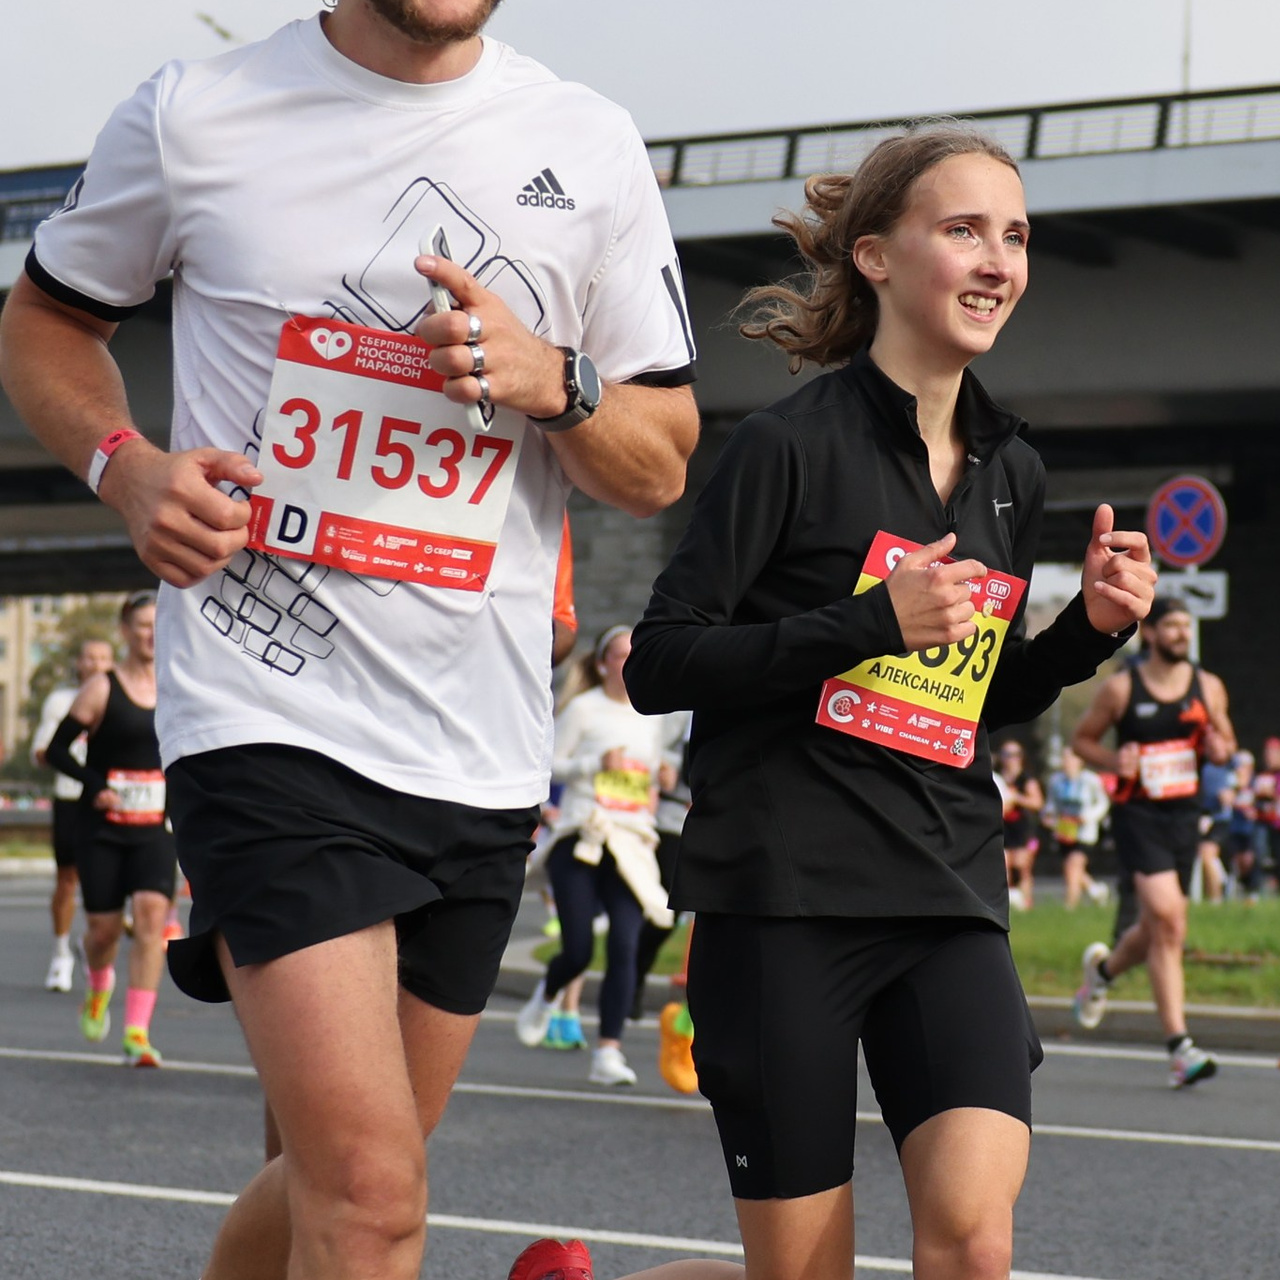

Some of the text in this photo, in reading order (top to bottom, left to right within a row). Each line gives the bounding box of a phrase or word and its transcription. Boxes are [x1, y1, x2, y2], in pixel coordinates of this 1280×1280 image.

[516, 192, 576, 211] adidas
[360, 335, 426, 356] СБЕРПРАЙМ
[355, 357, 422, 380] МАРАФОН
[357, 345, 432, 370] МОСКОВСК
[272, 397, 514, 506] 31537
[277, 503, 309, 544] D
[990, 582, 999, 593] 10
[867, 661, 966, 705] АЛЕКСАНДРА
[875, 723, 930, 745] VIBE CHANGAN
